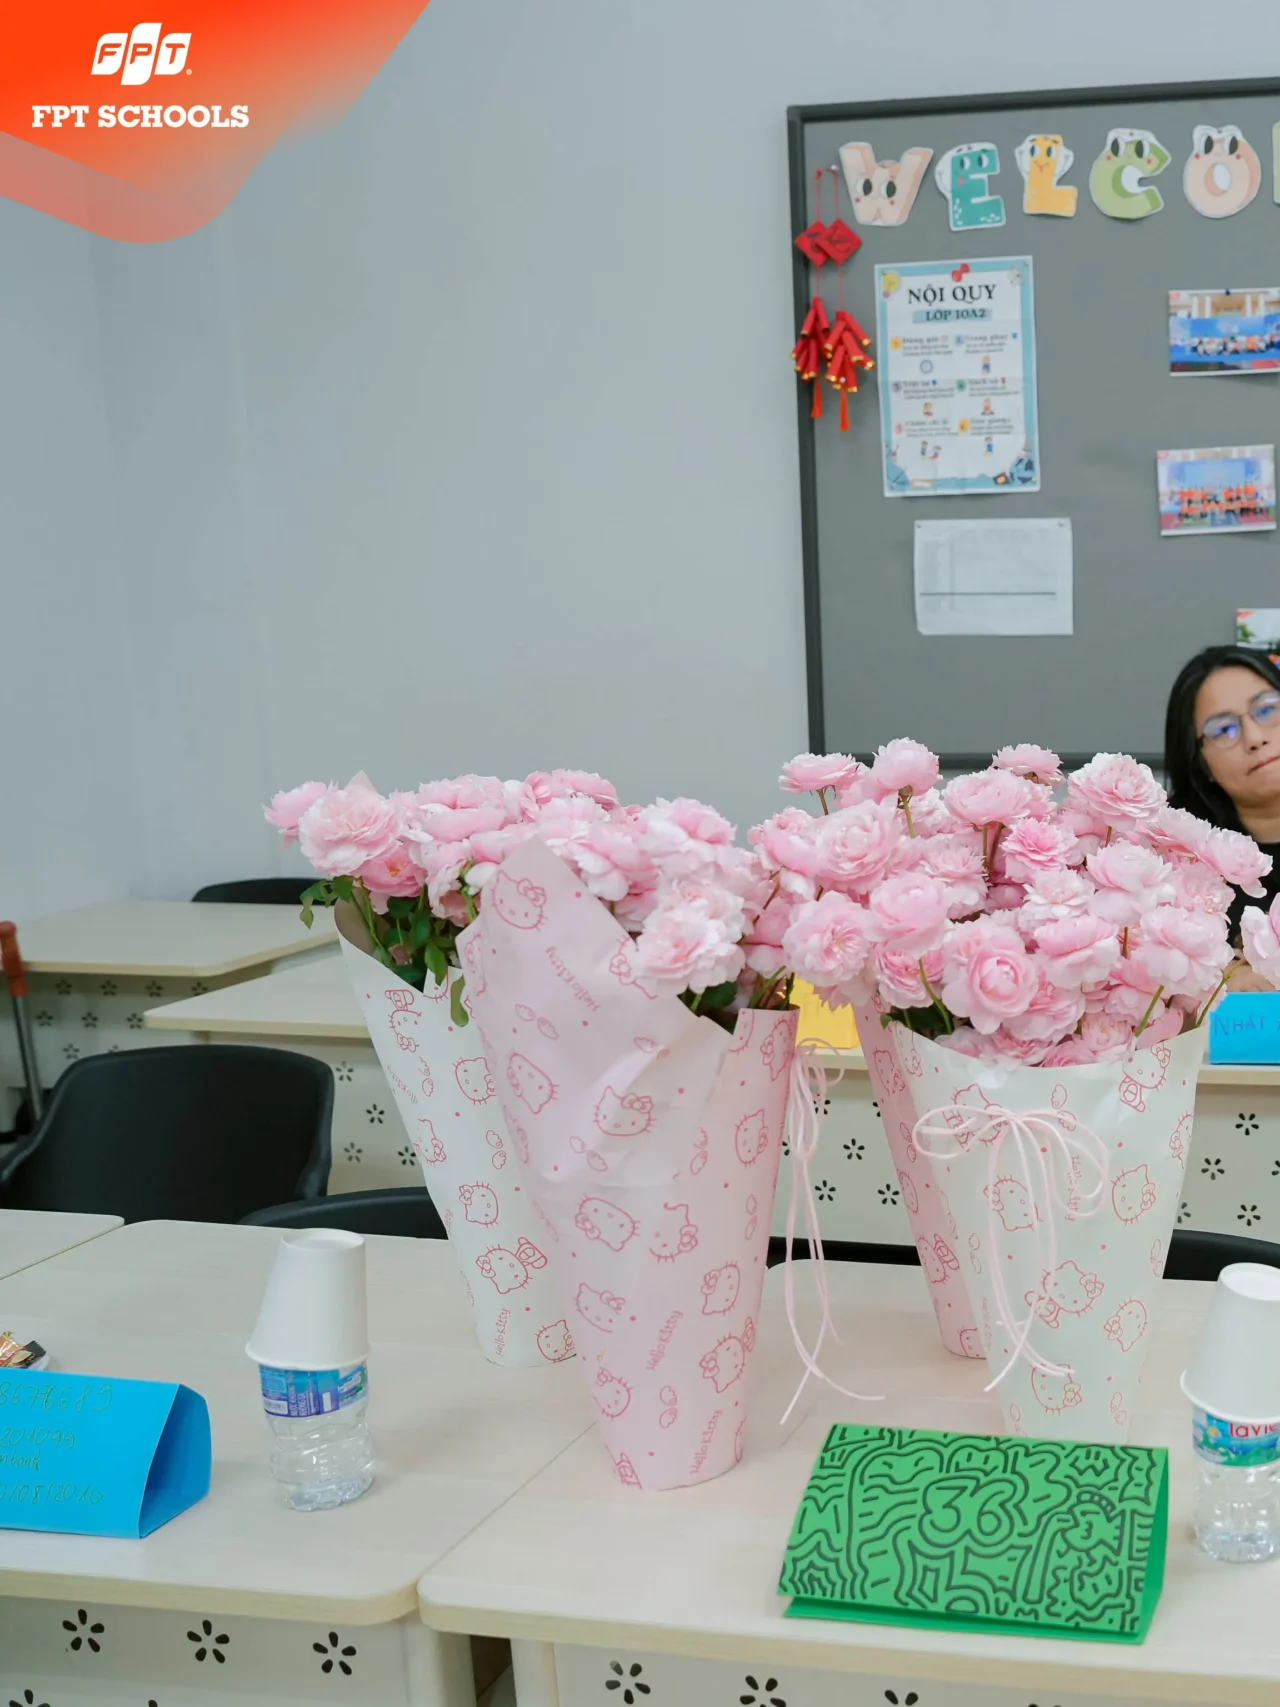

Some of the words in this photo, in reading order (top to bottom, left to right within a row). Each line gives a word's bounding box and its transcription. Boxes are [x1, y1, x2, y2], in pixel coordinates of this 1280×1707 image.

[907, 284, 946, 306] NỘI
[951, 284, 998, 304] QUY
[928, 1484, 1005, 1537] 36
